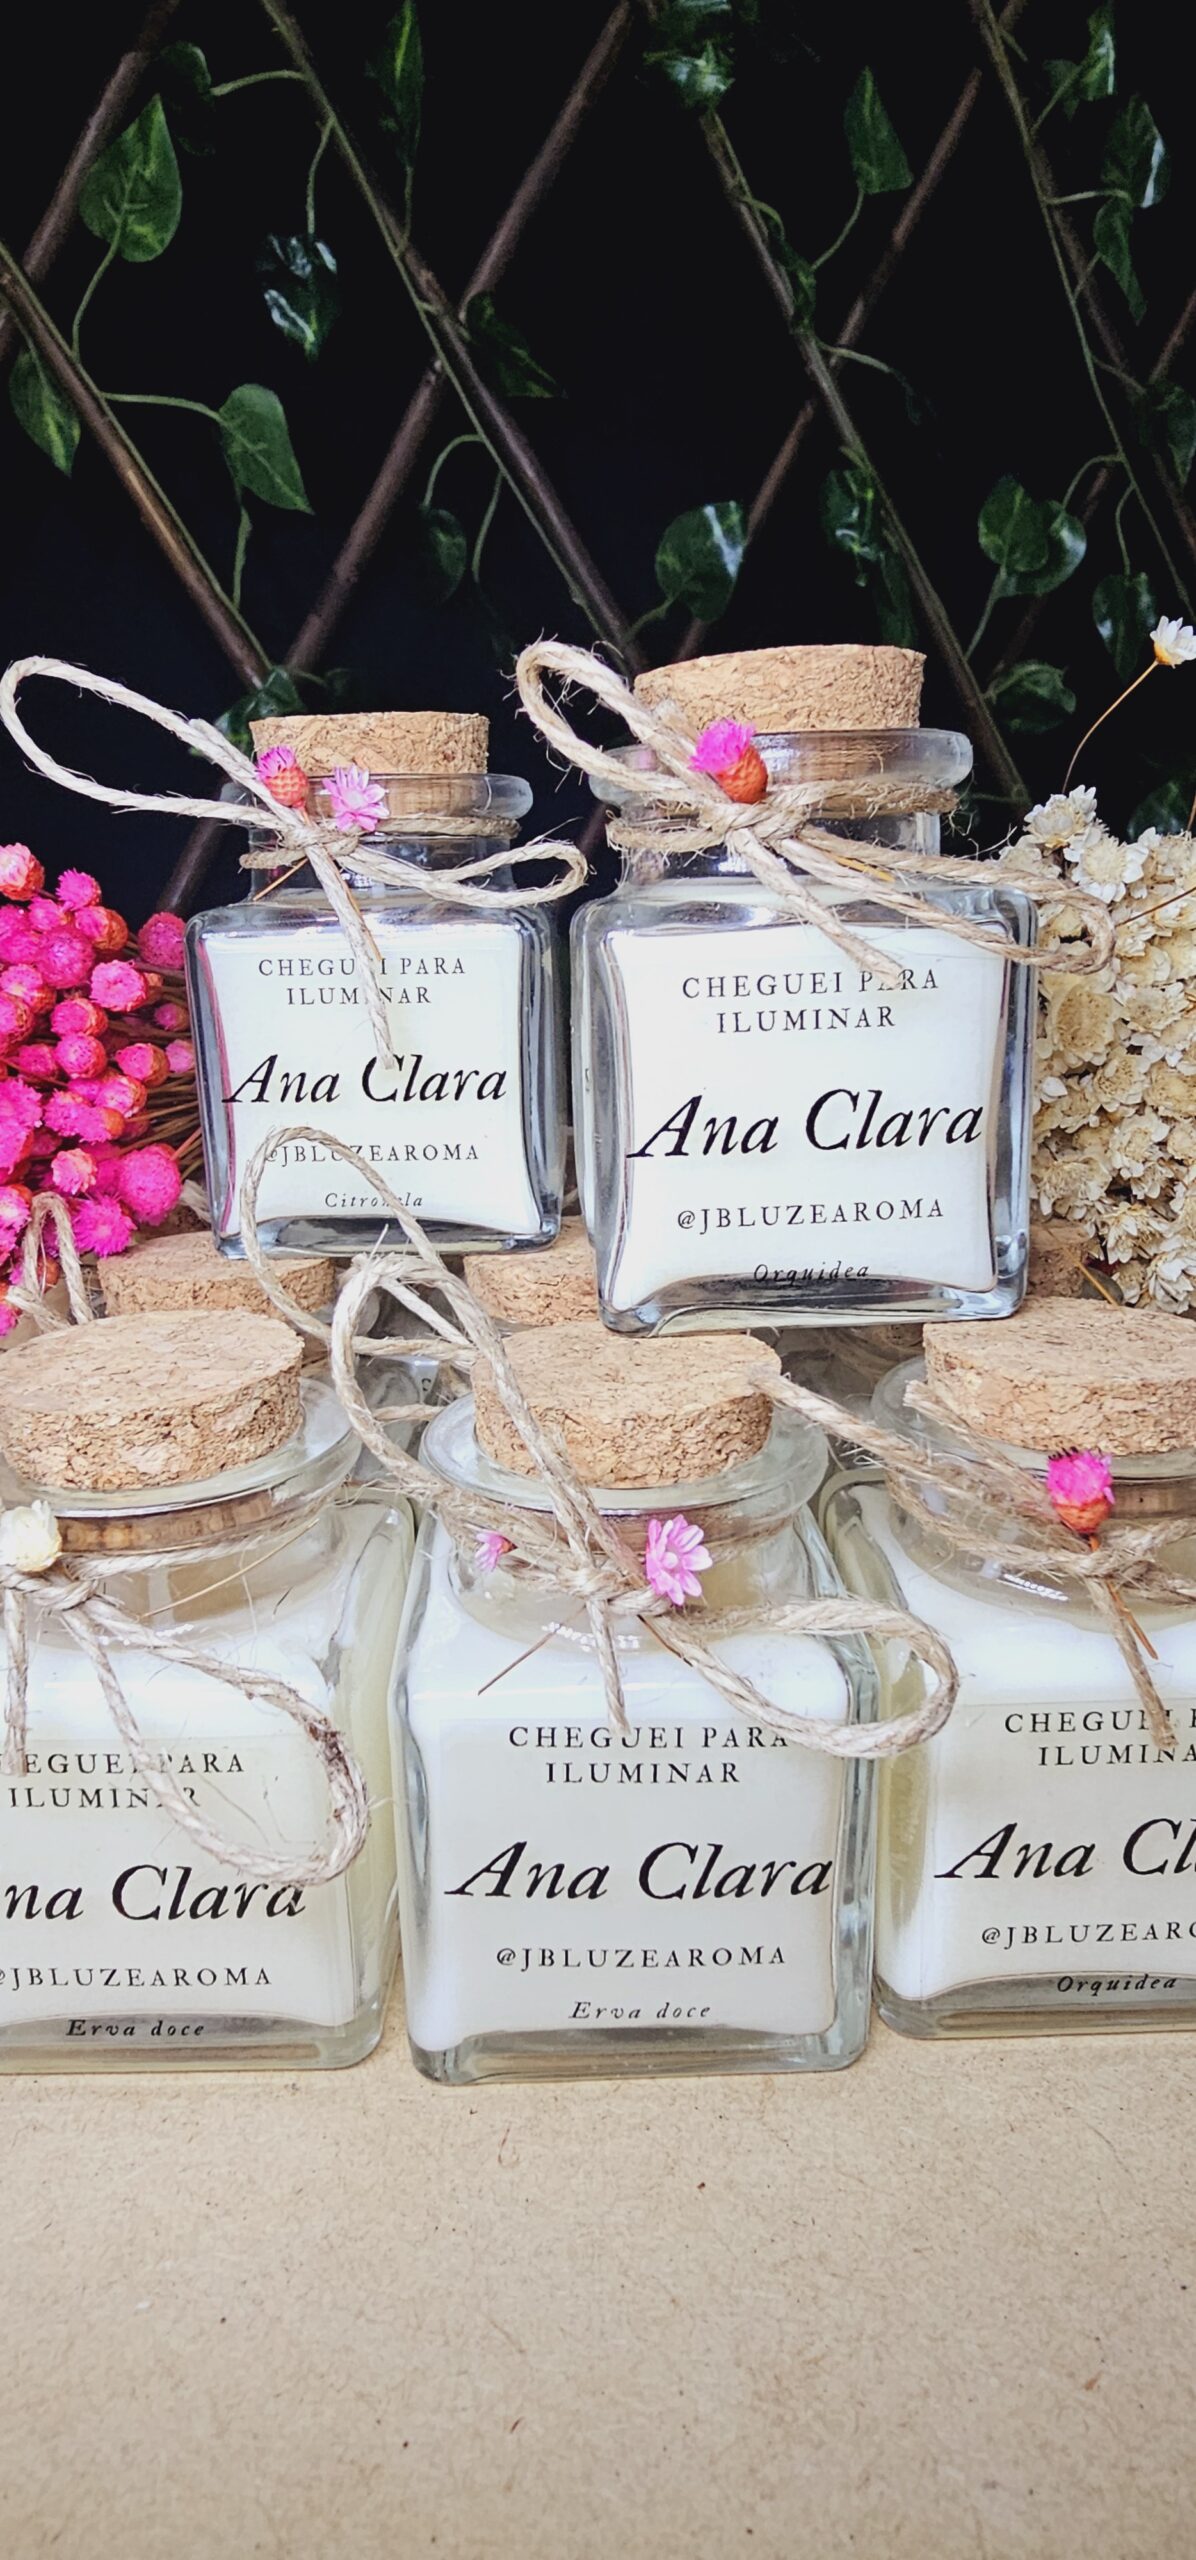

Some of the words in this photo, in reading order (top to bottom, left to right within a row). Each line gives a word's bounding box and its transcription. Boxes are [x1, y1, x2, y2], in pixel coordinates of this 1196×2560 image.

[258, 957, 388, 976] CHEGUI
[400, 957, 466, 975] PARA
[287, 987, 432, 1005] ILUMNAR
[682, 971, 842, 999] CHEGUEI
[859, 969, 939, 992] PRA
[717, 1006, 897, 1033] ILUMINAR
[222, 1054, 341, 1103] Ana
[362, 1053, 507, 1102] Clara
[626, 1094, 780, 1158] Ana
[805, 1089, 984, 1150] Clara
[325, 1192, 423, 1207] Citrola
[677, 1198, 945, 1234] @JBLUZEAROMA
[753, 1260, 870, 1287] Orquidea
[509, 1726, 684, 1748] CHEGUEI
[702, 1726, 788, 1748] PARA
[0, 1753, 143, 1774] EGUE
[1038, 1743, 1196, 1766] ILUMINA
[545, 1761, 740, 1783] ILUMINAR
[8, 1787, 201, 1808] ILUMINR
[934, 1822, 1096, 1879] Ana
[1123, 1818, 1196, 1875] Cl
[444, 1841, 610, 1899] Ana
[638, 1841, 834, 1900] Clara
[112, 1864, 306, 1920] Clara
[496, 1946, 786, 1972] @JBLUZEAROMA
[1056, 1973, 1178, 1997] Orquidea
[568, 2001, 642, 2020] Erva
[656, 2001, 712, 2019] doce
[66, 2018, 136, 2037] Erva
[150, 2020, 206, 2037] doce
